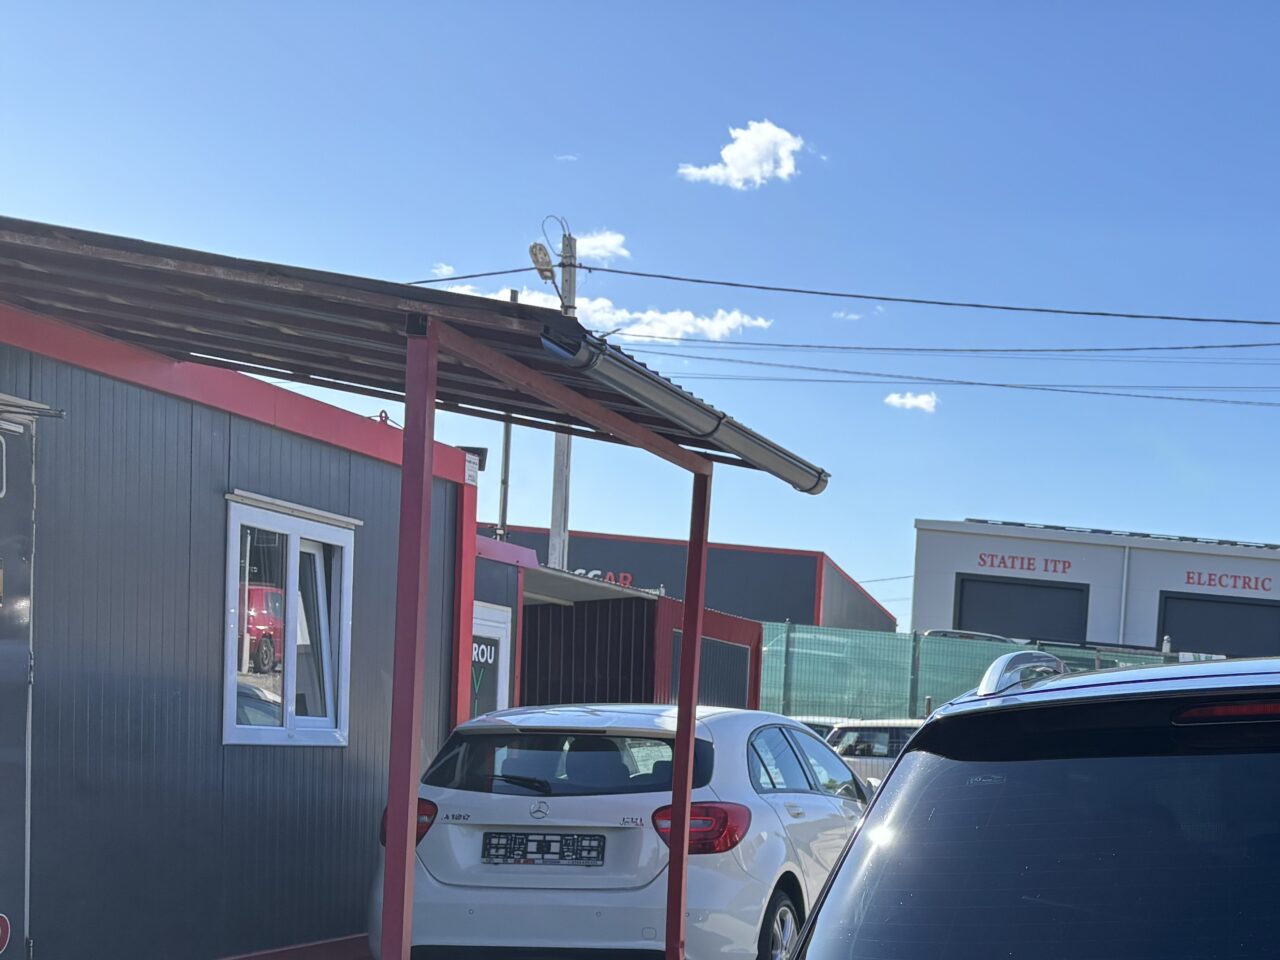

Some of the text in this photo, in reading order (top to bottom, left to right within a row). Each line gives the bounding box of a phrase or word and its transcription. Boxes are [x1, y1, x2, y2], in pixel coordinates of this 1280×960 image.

[978, 553, 1072, 574] STATIE ITP
[1185, 571, 1272, 592] ELECTRIC
